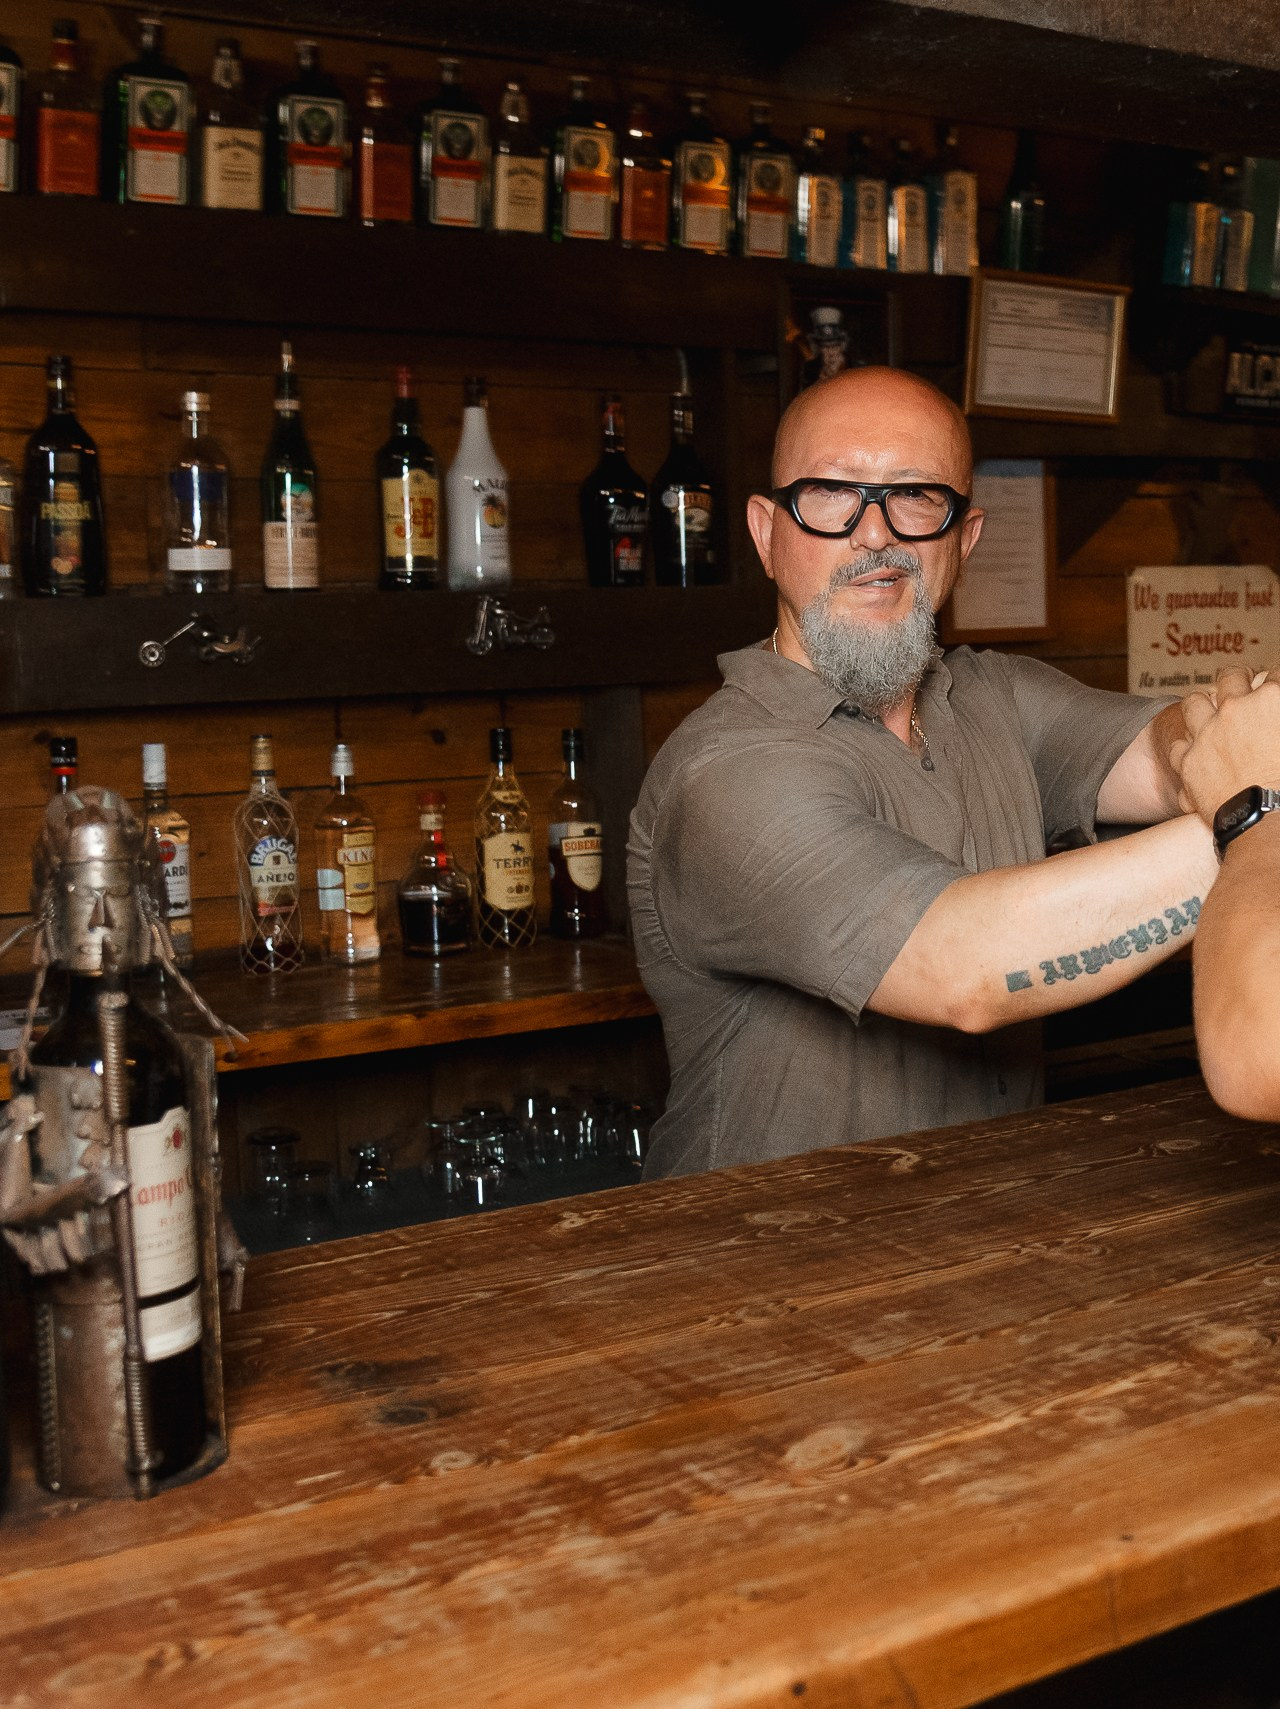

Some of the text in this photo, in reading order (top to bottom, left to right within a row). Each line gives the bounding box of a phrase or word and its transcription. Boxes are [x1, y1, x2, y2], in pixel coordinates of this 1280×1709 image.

[1134, 582, 1273, 616] We guarantee fast
[1166, 622, 1244, 657] Service
[1139, 671, 1154, 688] No
[1160, 671, 1190, 687] matter
[564, 839, 602, 852] SOBERA
[165, 866, 188, 877] ARDI
[258, 871, 295, 884] AÑEJO
